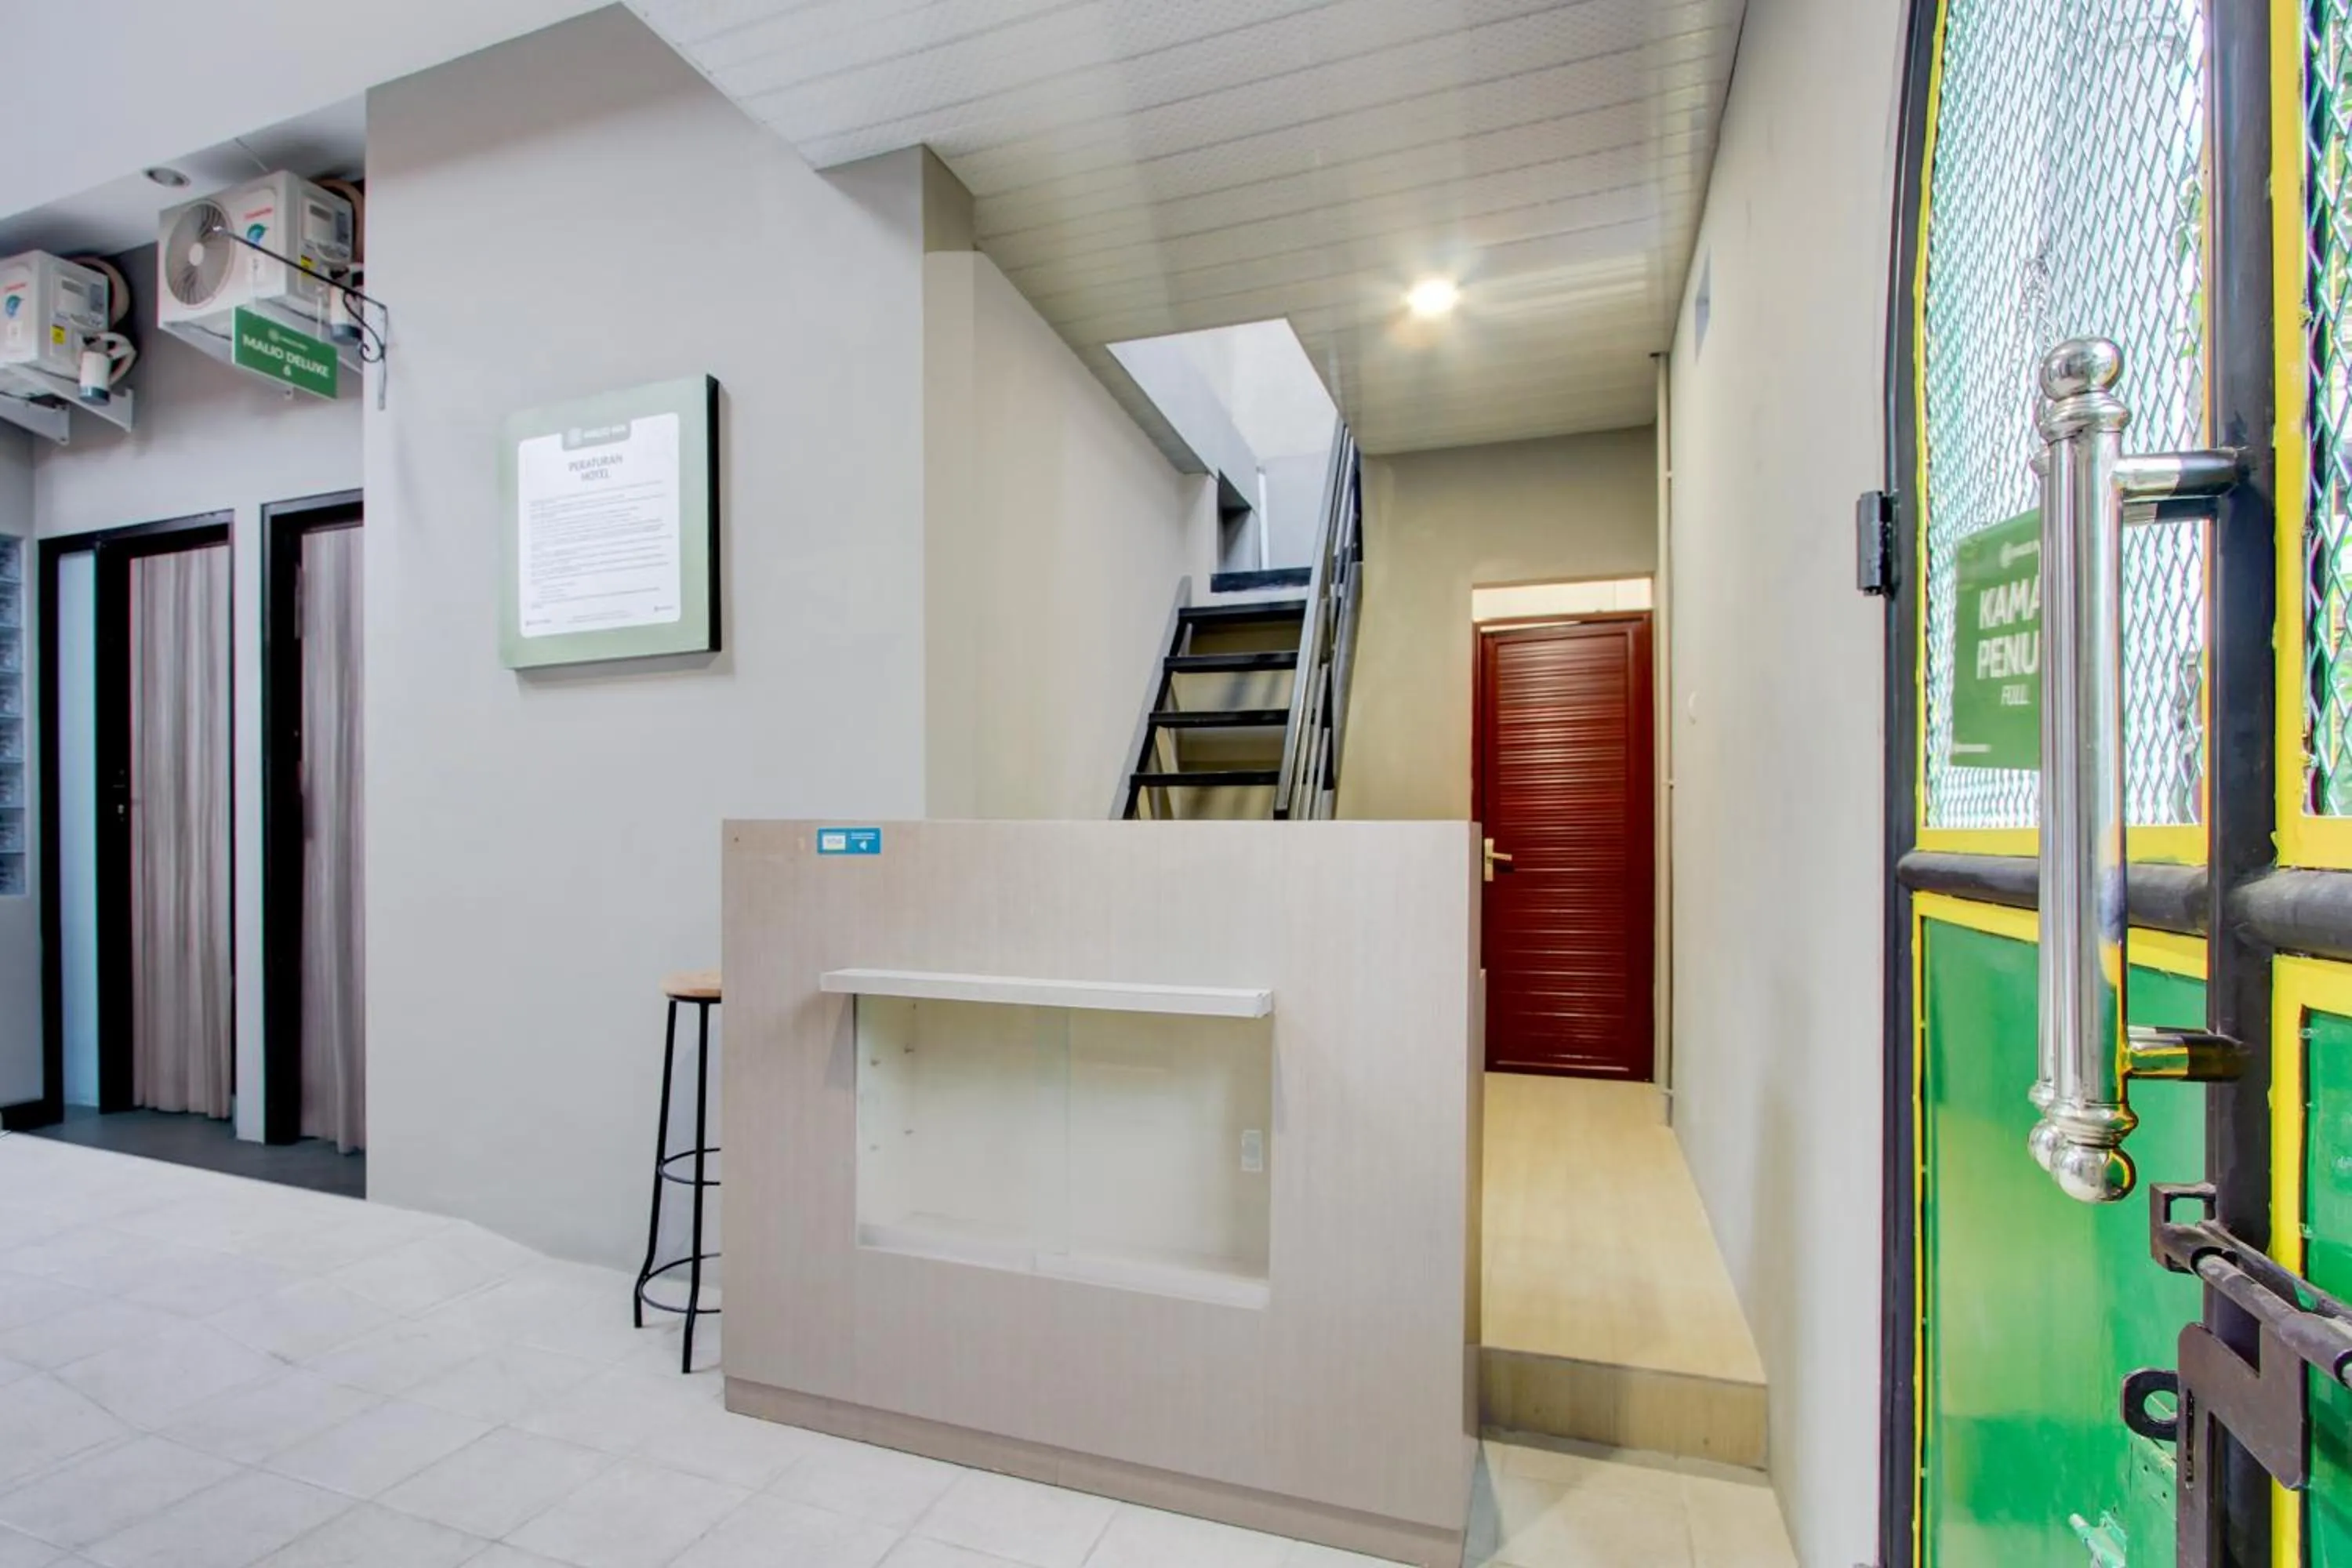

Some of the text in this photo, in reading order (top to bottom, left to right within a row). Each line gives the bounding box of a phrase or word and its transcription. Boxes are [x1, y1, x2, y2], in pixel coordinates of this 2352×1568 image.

[242, 333, 283, 359] MALIO
[286, 351, 329, 378] DELUXE
[568, 453, 623, 472] PERATURAN
[581, 468, 611, 481] HOTEL
[1979, 575, 2041, 630] KAMA
[1976, 630, 2040, 680] PENU
